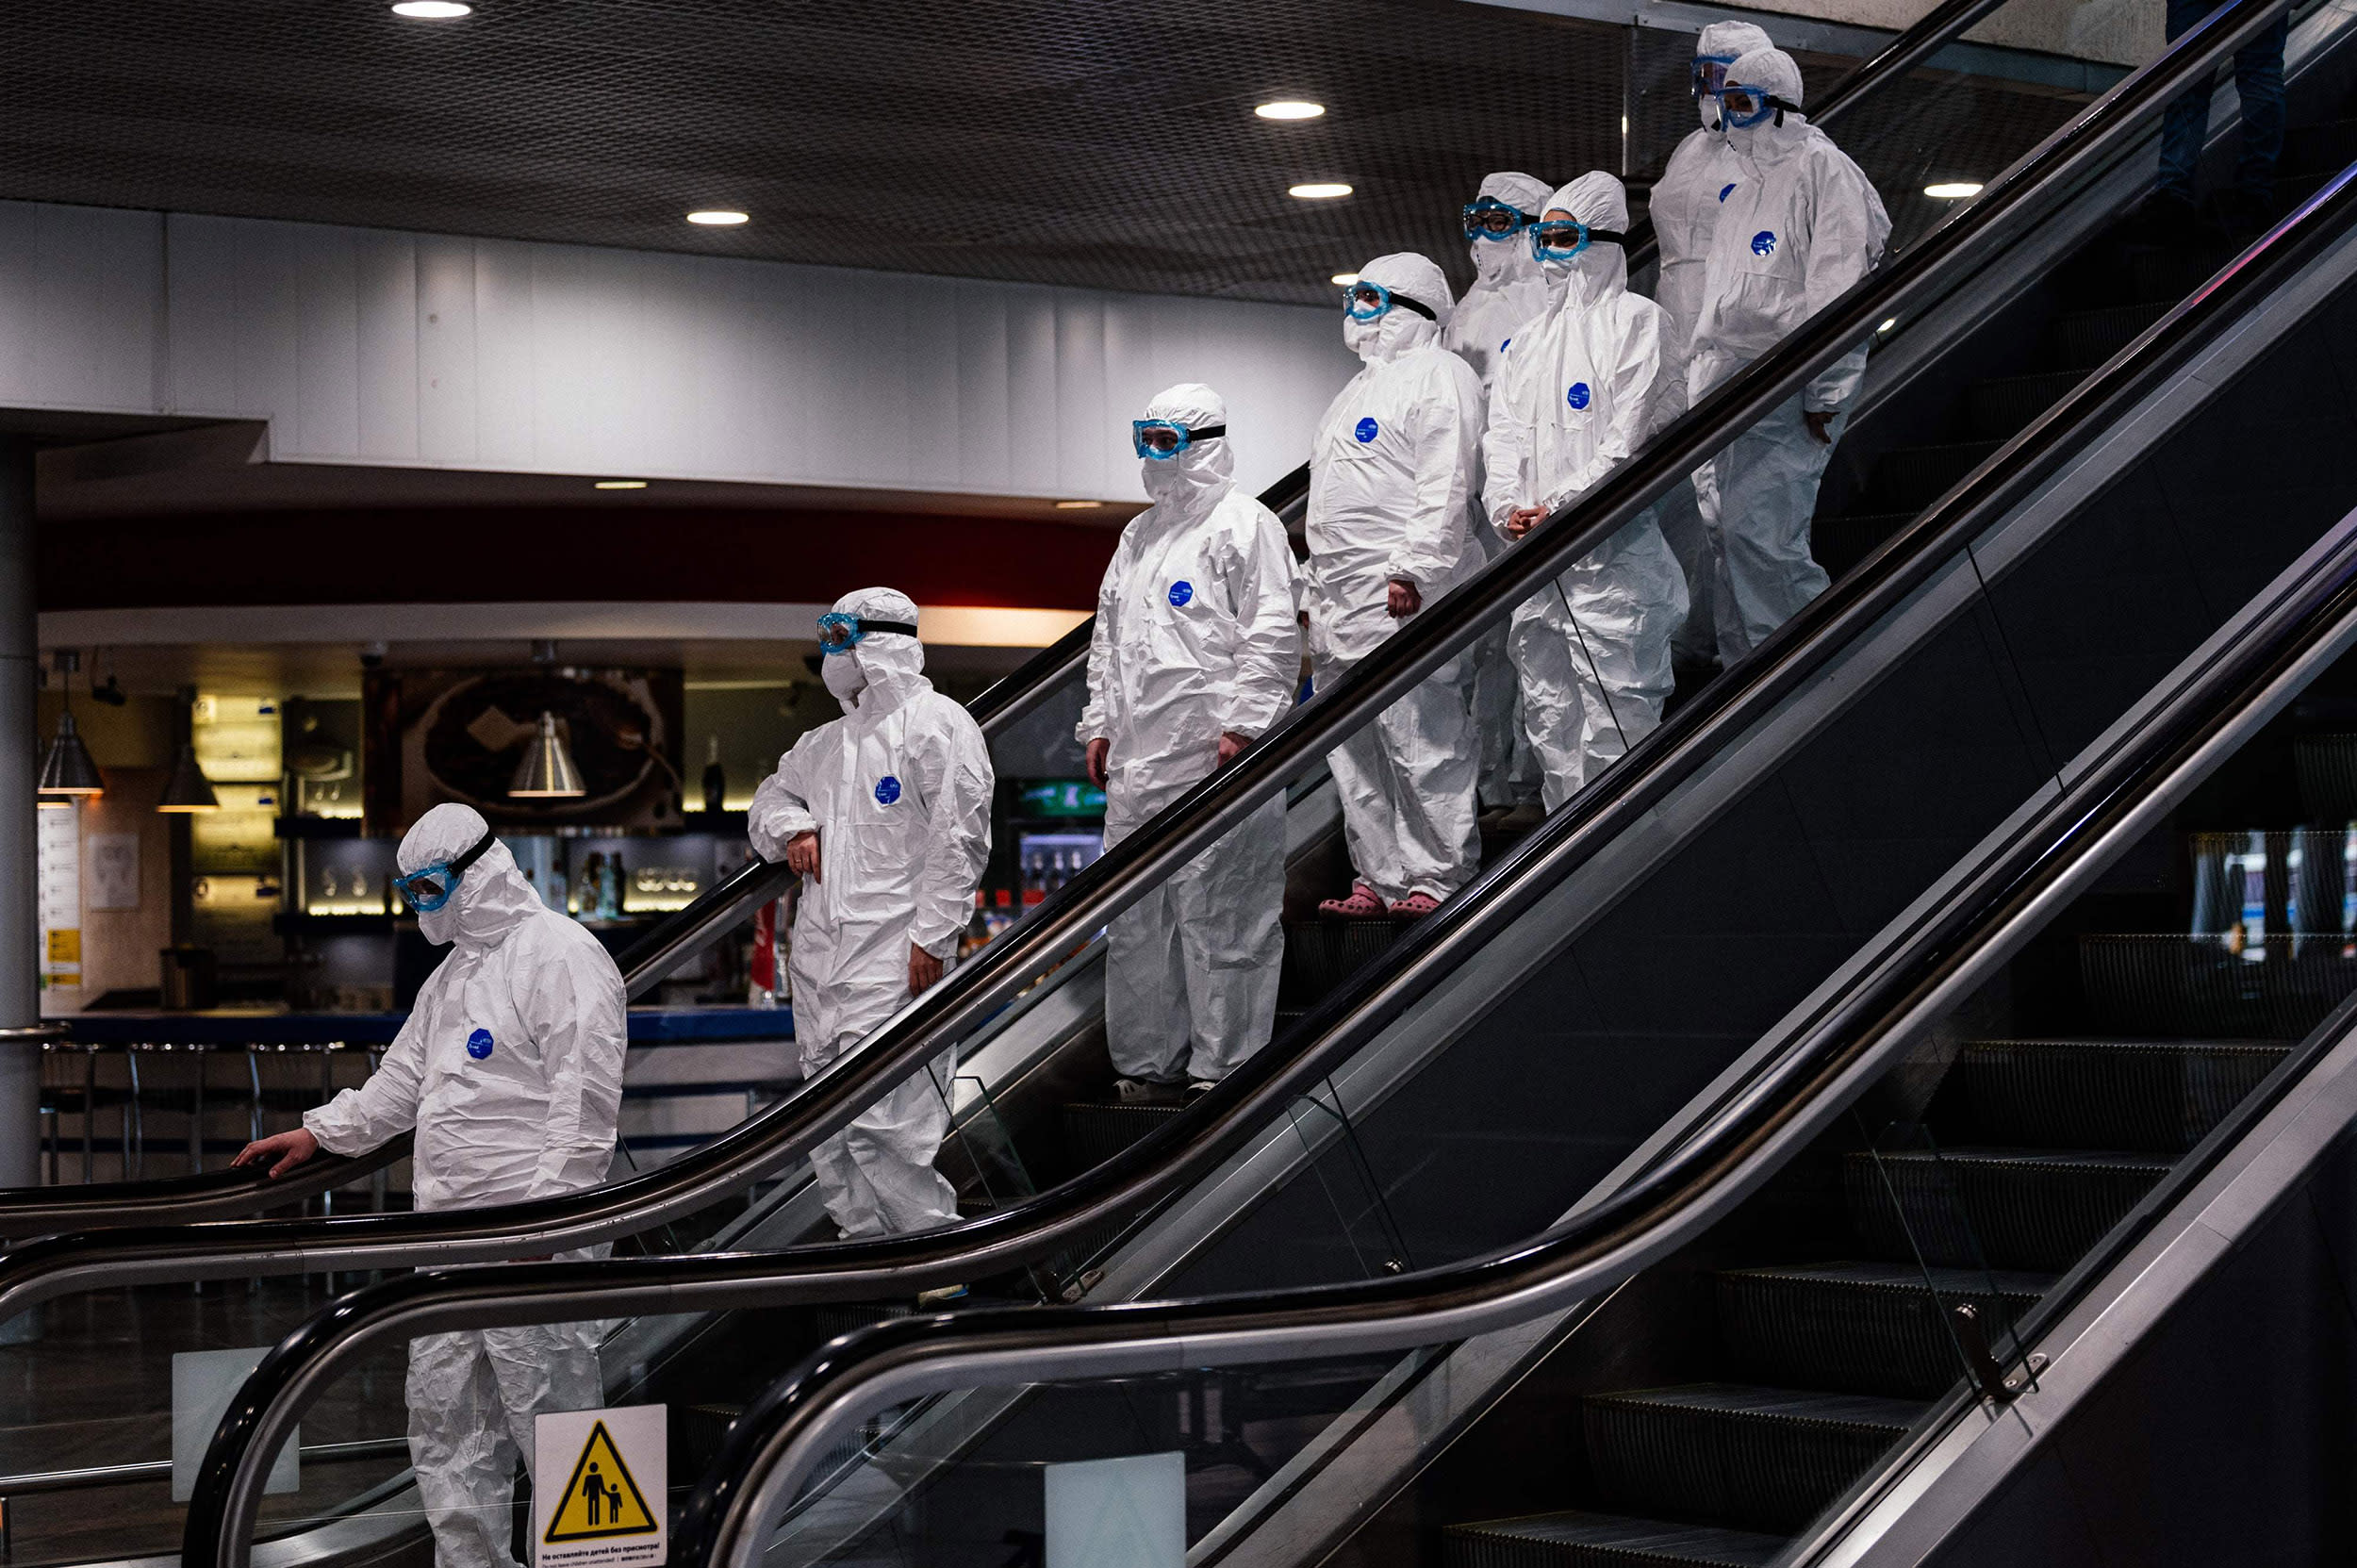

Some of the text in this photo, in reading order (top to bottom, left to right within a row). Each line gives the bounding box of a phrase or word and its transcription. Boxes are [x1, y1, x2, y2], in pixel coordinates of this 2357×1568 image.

[552, 1550, 589, 1560] оставляйте
[590, 1547, 609, 1557] детей
[610, 1545, 621, 1554] без
[622, 1543, 660, 1553] присмотра!
